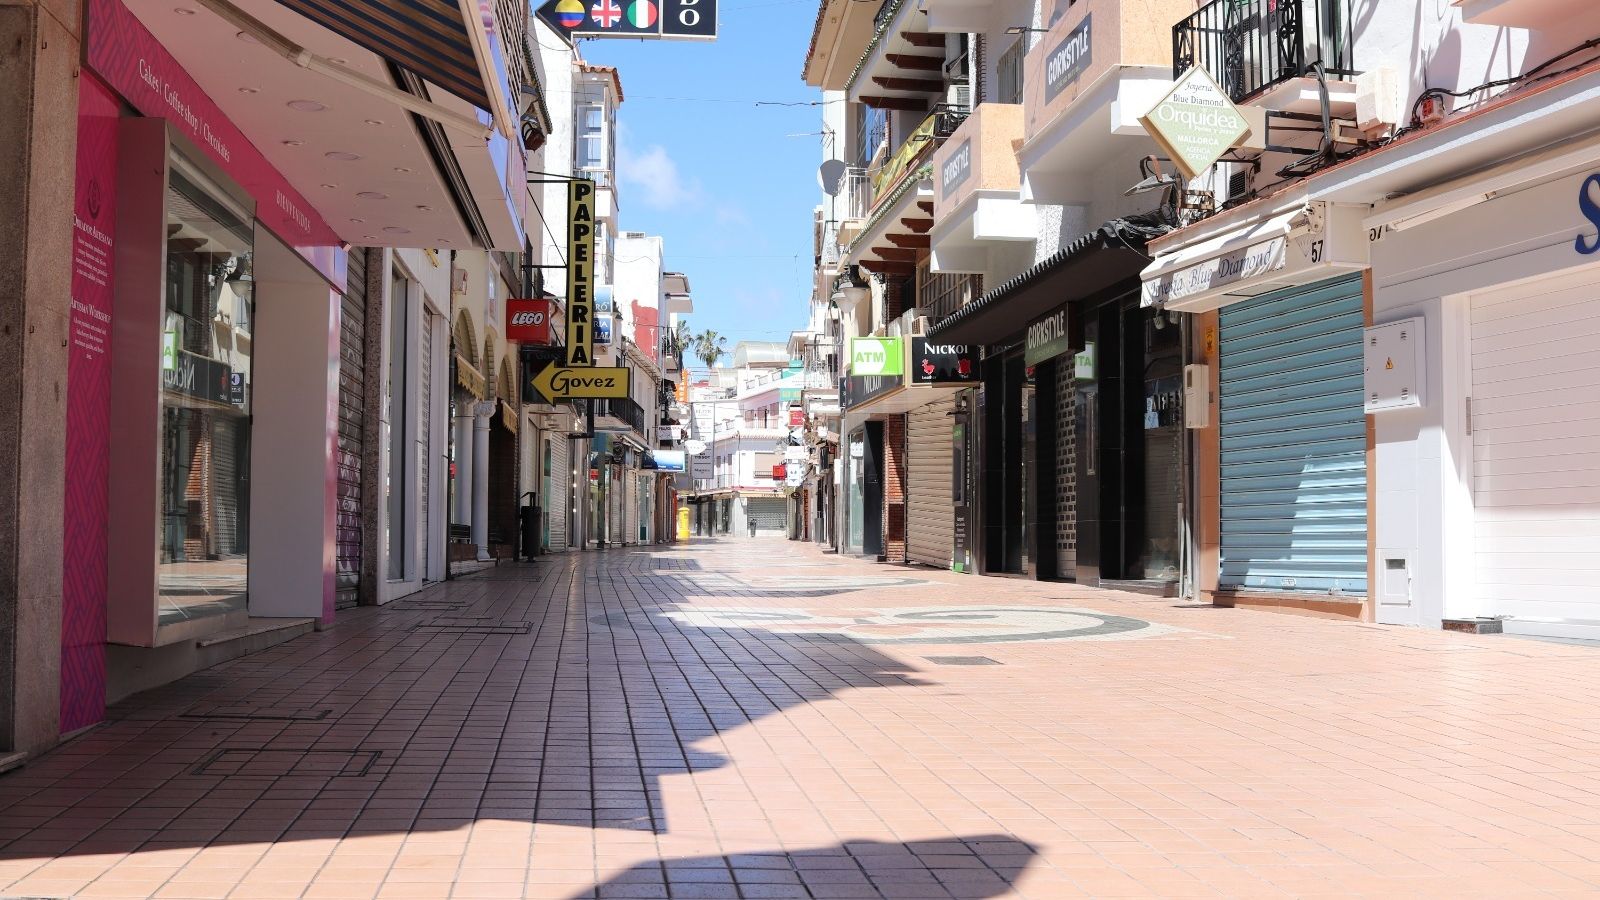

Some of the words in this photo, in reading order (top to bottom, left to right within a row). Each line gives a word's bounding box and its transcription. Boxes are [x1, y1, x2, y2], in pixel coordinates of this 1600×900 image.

[1048, 25, 1089, 86] CORKSTYLE
[139, 58, 160, 93] Cakes
[164, 83, 184, 117] Coffee
[184, 105, 198, 136] shop
[1173, 93, 1189, 104] Blue
[1190, 96, 1224, 107] Diamond
[943, 146, 969, 187] CORKSTYLE
[1188, 264, 1213, 289] Blue
[1219, 240, 1276, 279] Diamond
[1311, 240, 1324, 263] 57
[570, 183, 592, 365] PAPELERIA
[511, 312, 545, 326] LEGO
[1028, 310, 1065, 350] CORKSTYLE
[855, 351, 884, 363] ATM
[550, 369, 615, 396] Govez
